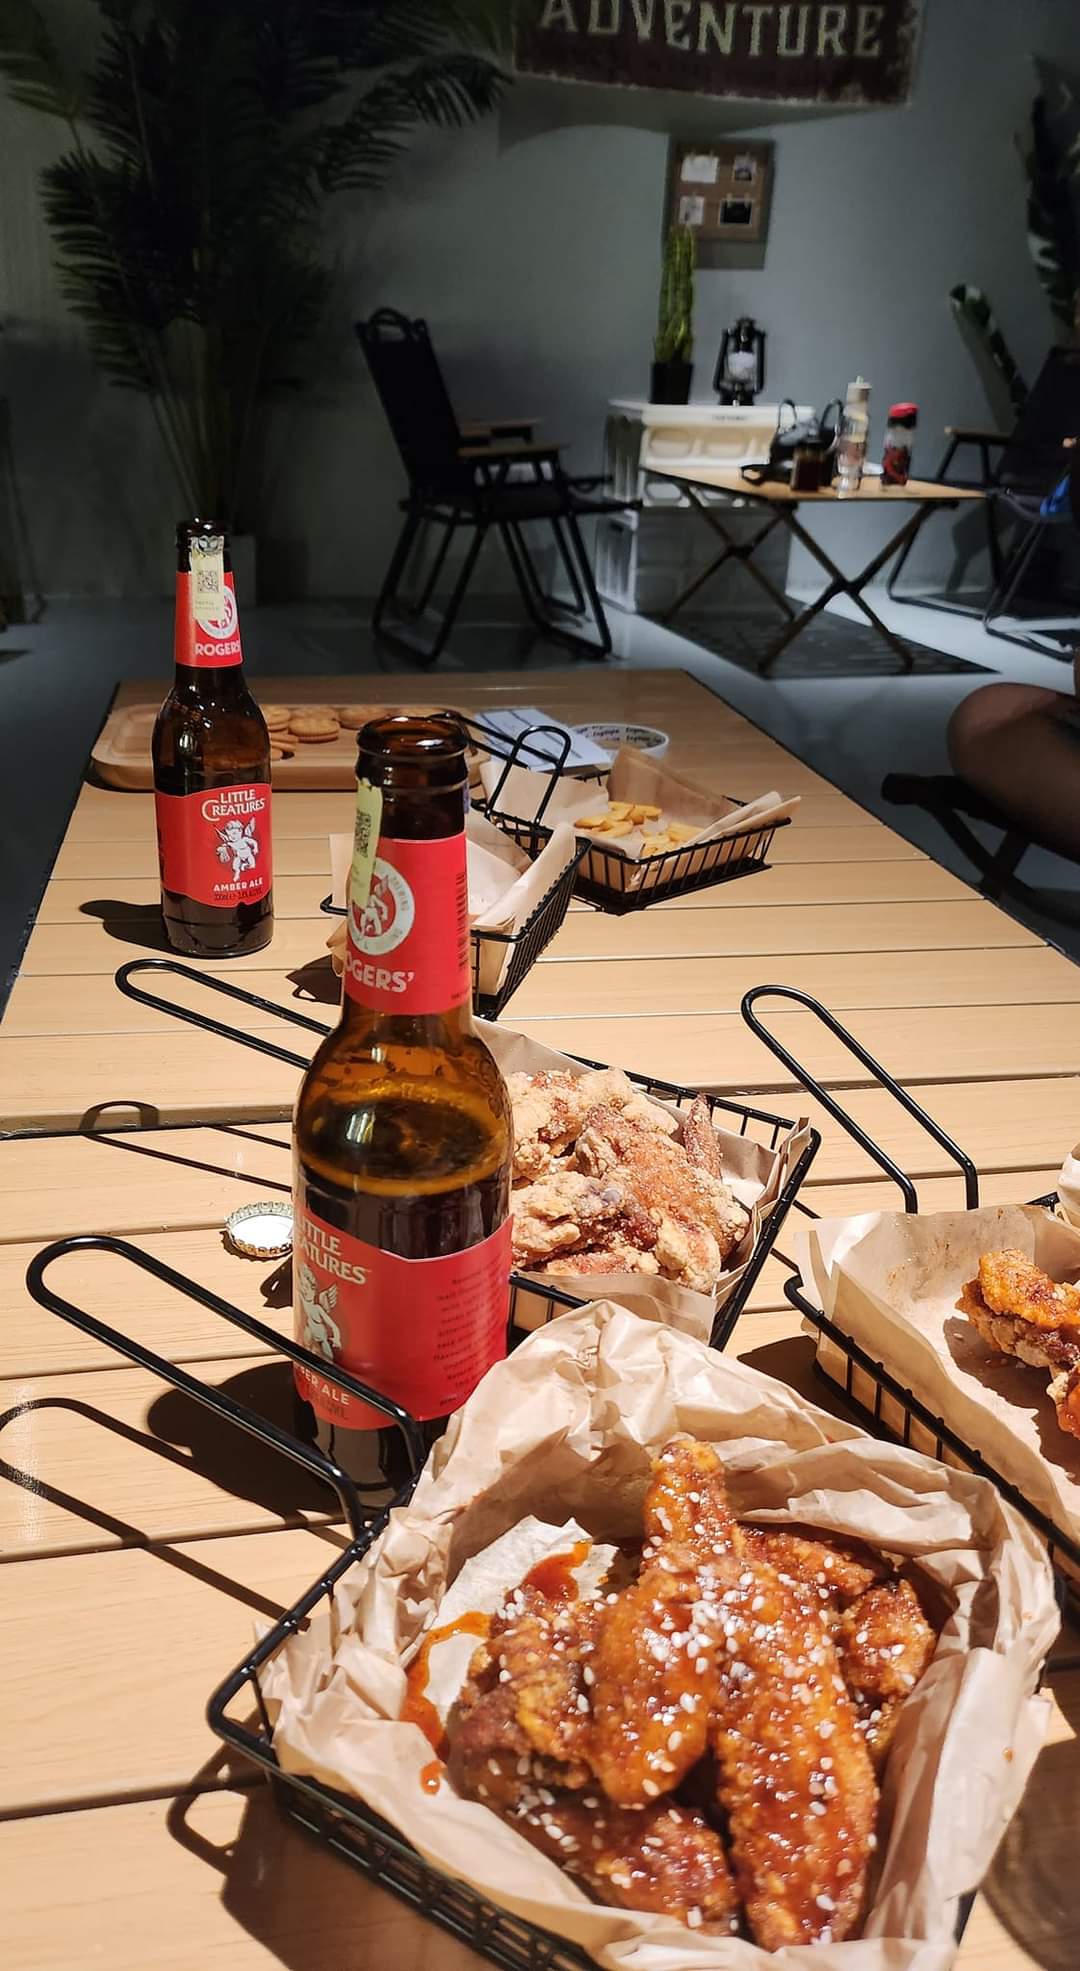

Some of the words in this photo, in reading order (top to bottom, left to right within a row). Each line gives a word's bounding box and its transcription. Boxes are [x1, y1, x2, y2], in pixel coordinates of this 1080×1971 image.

[540, 0, 884, 57] ADVENTURE
[220, 789, 256, 803] LITTLE
[201, 798, 265, 821] CREATURES
[213, 881, 247, 891] AMBER
[249, 877, 263, 887] ALE
[346, 950, 415, 993] OGERS'
[321, 1383, 350, 1406] ALE
